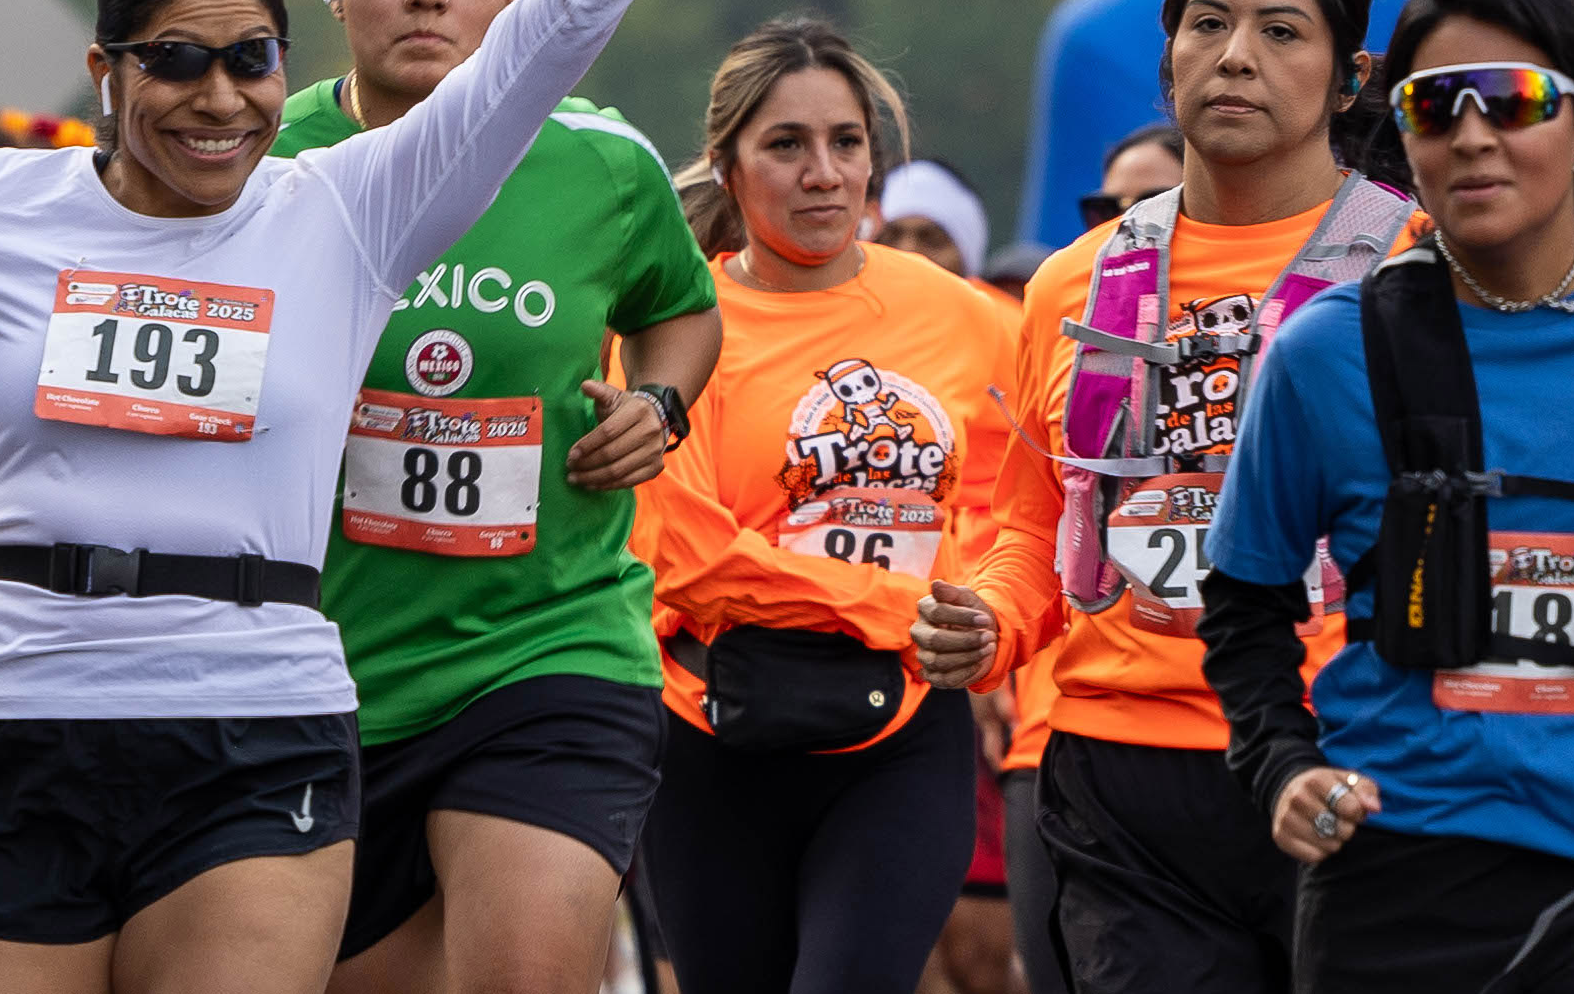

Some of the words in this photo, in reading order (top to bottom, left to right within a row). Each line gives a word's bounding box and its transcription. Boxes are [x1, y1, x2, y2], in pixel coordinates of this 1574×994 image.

[139, 284, 200, 312] Trote
[393, 263, 556, 327] XICO
[138, 303, 199, 320] Calacas
[206, 303, 256, 322] 2025
[85, 318, 220, 398] 193
[426, 409, 482, 434] Trote
[1166, 411, 1192, 428] de
[1206, 401, 1235, 418] las
[197, 421, 218, 435] 193
[485, 420, 528, 438] 2025
[1153, 410, 1238, 455] Cala
[799, 435, 945, 486] Trote
[400, 447, 483, 516] 88
[867, 467, 892, 481] las
[845, 498, 895, 519] Trote
[898, 510, 935, 524] 2025
